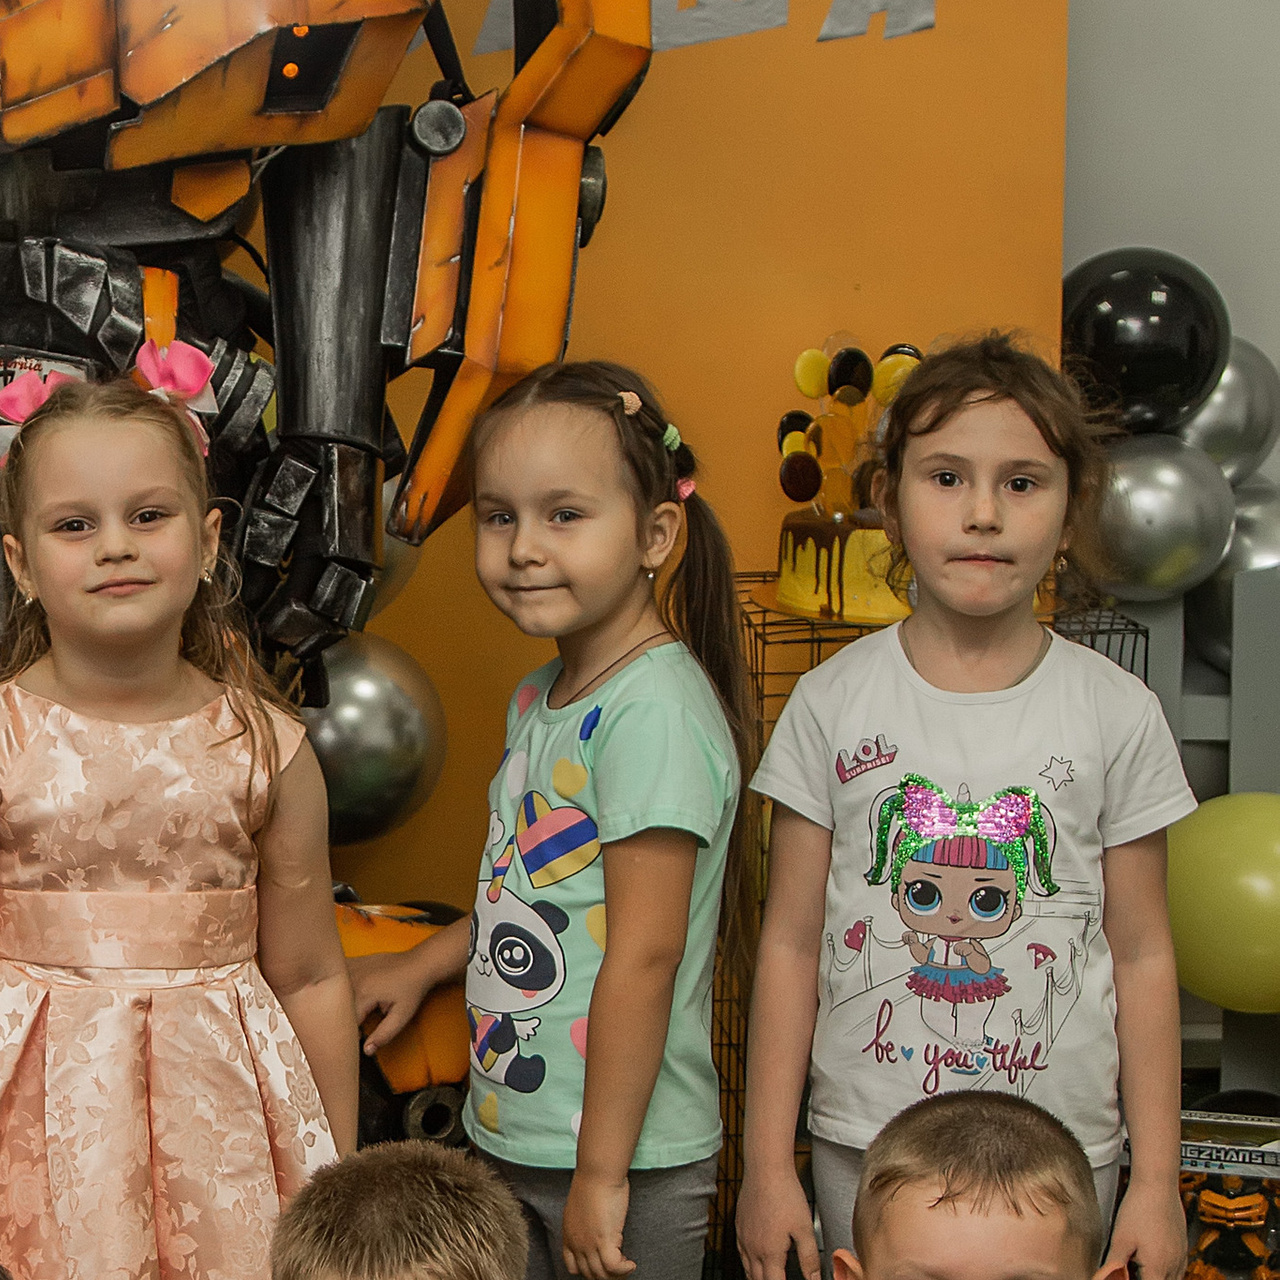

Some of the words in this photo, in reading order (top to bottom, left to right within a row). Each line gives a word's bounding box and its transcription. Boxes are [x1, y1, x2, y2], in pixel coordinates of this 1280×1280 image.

[845, 756, 891, 780] SURPRISE!
[862, 998, 898, 1063] be
[919, 1040, 979, 1095] you
